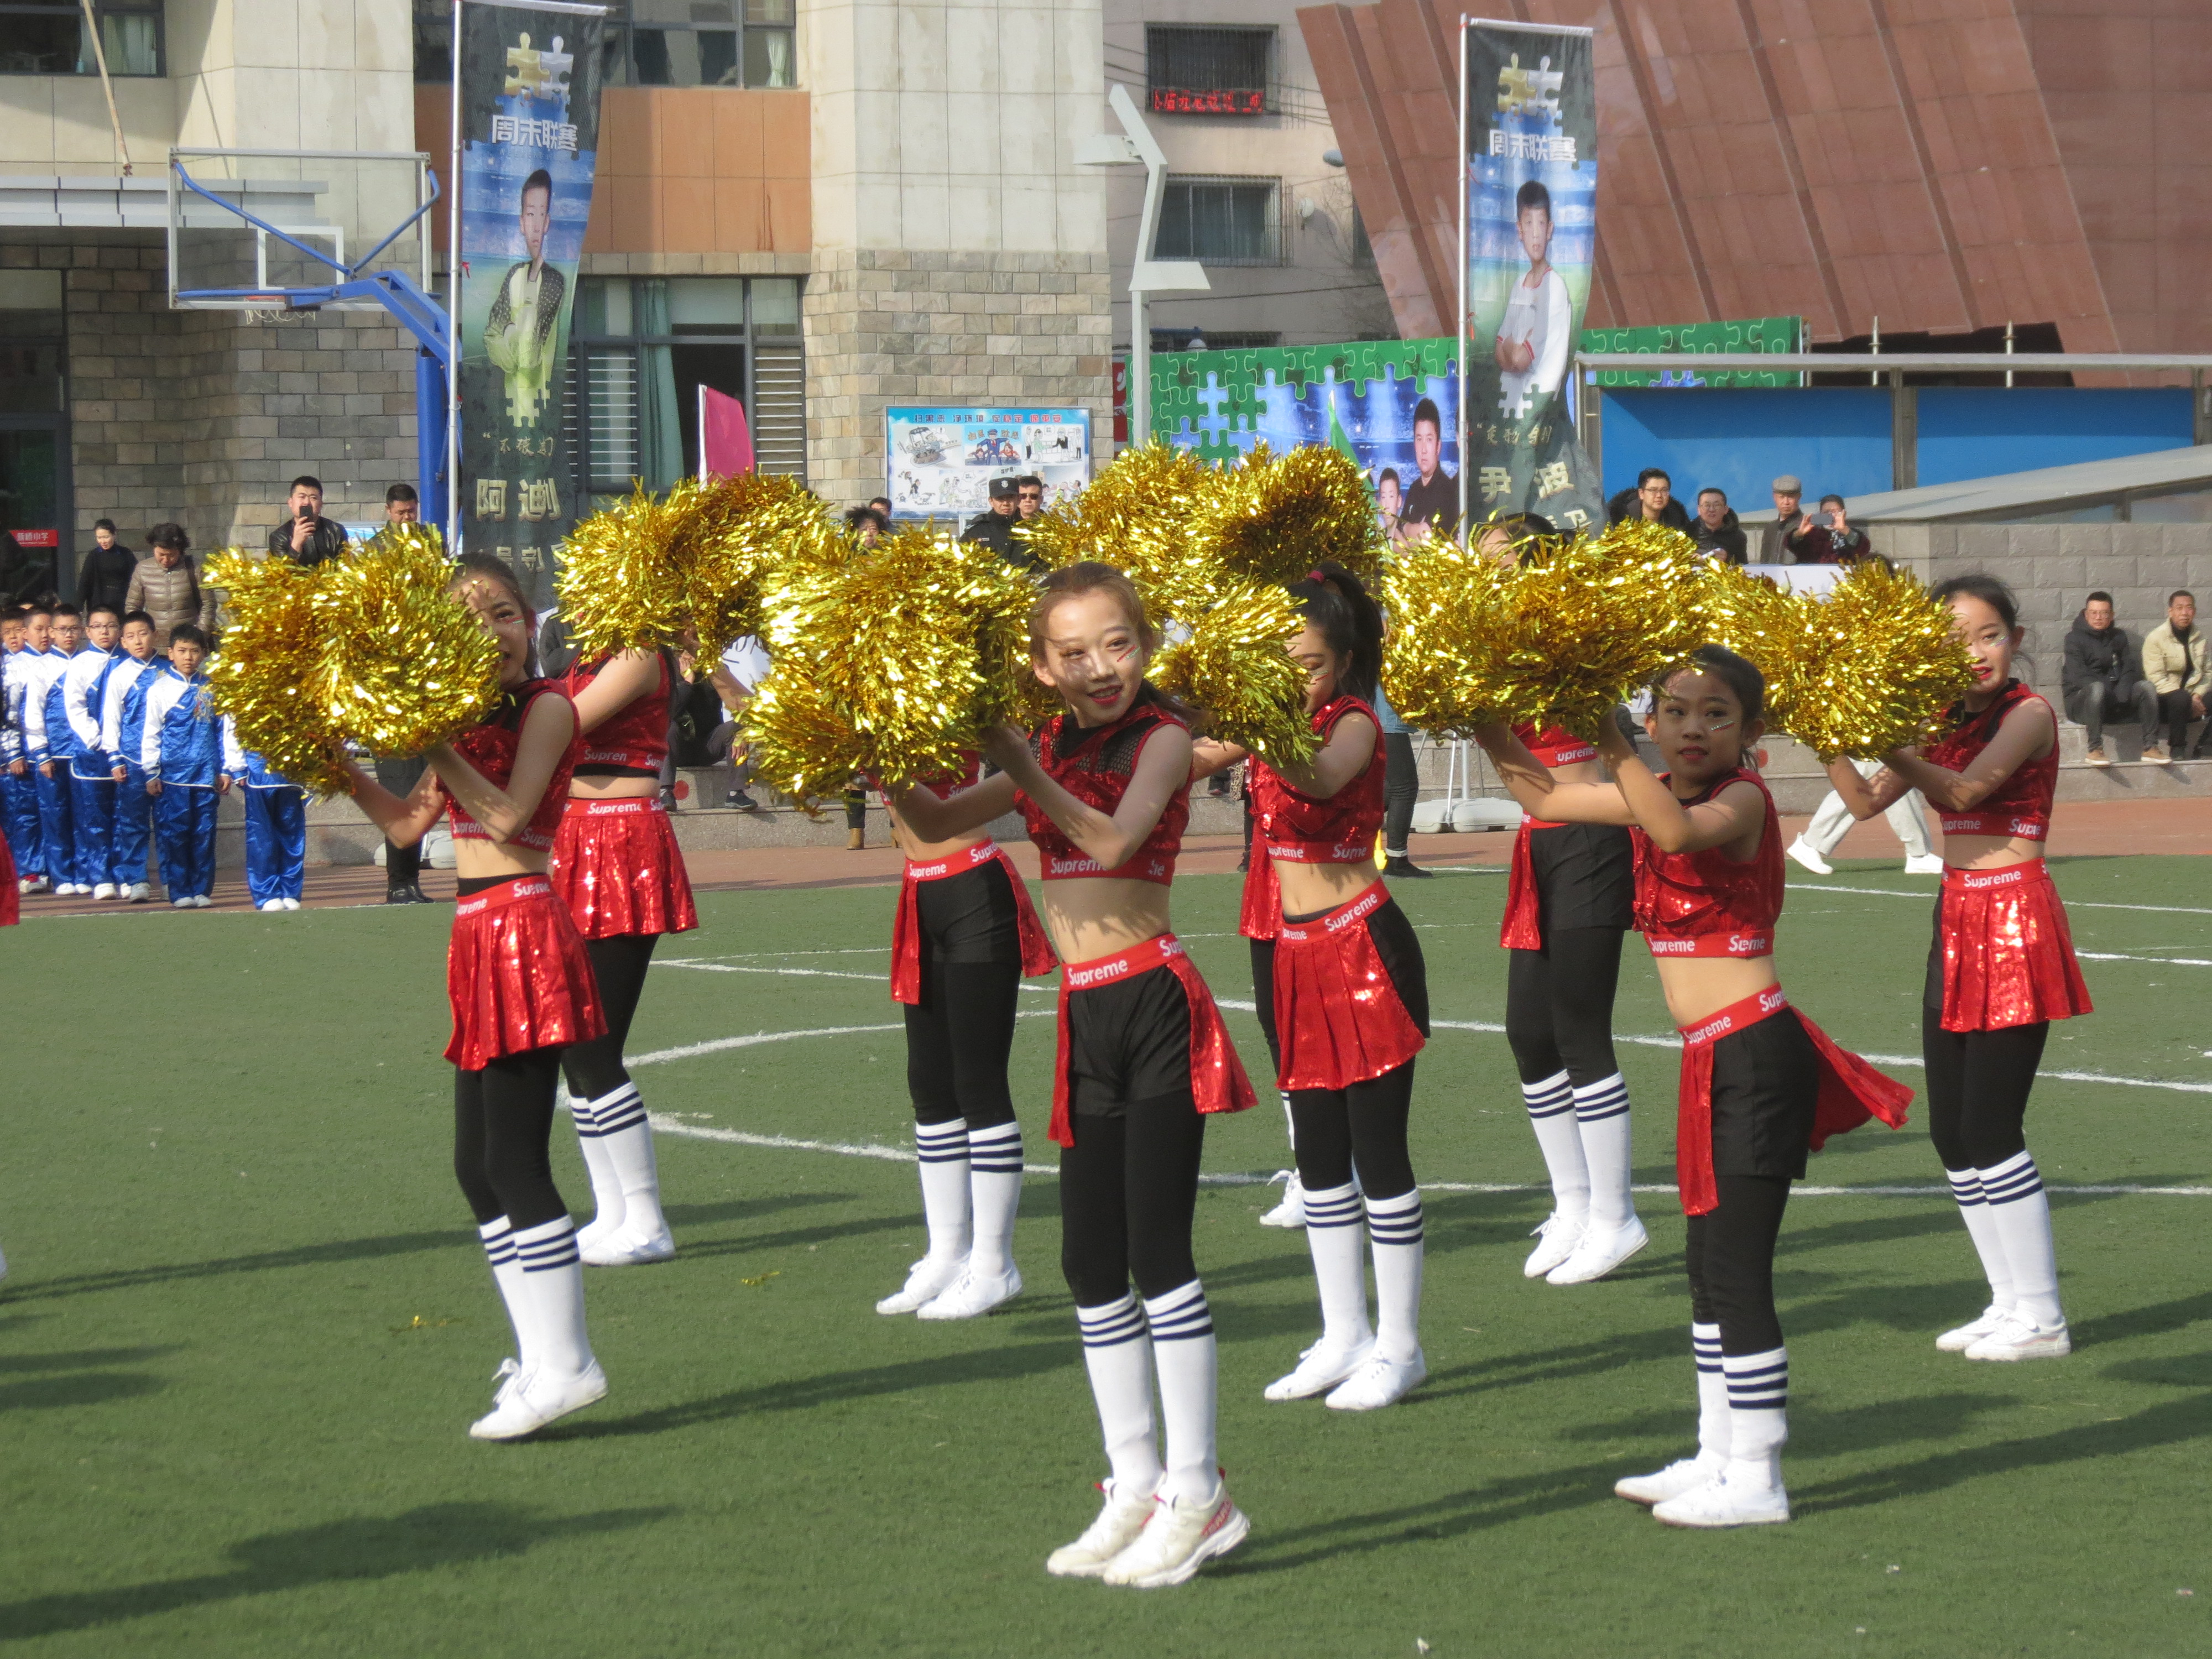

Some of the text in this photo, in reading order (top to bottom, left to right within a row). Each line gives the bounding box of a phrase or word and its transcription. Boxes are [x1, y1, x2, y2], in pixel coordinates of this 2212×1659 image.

[492, 114, 578, 152] 周末联赛
[1489, 129, 1577, 161] 周末联赛
[909, 863, 947, 878] Supreme
[1964, 870, 2022, 888] Supreme
[1324, 893, 1378, 932] Supreme
[1068, 959, 1128, 986] Supreme
[1683, 1016, 1732, 1045] Supreme
